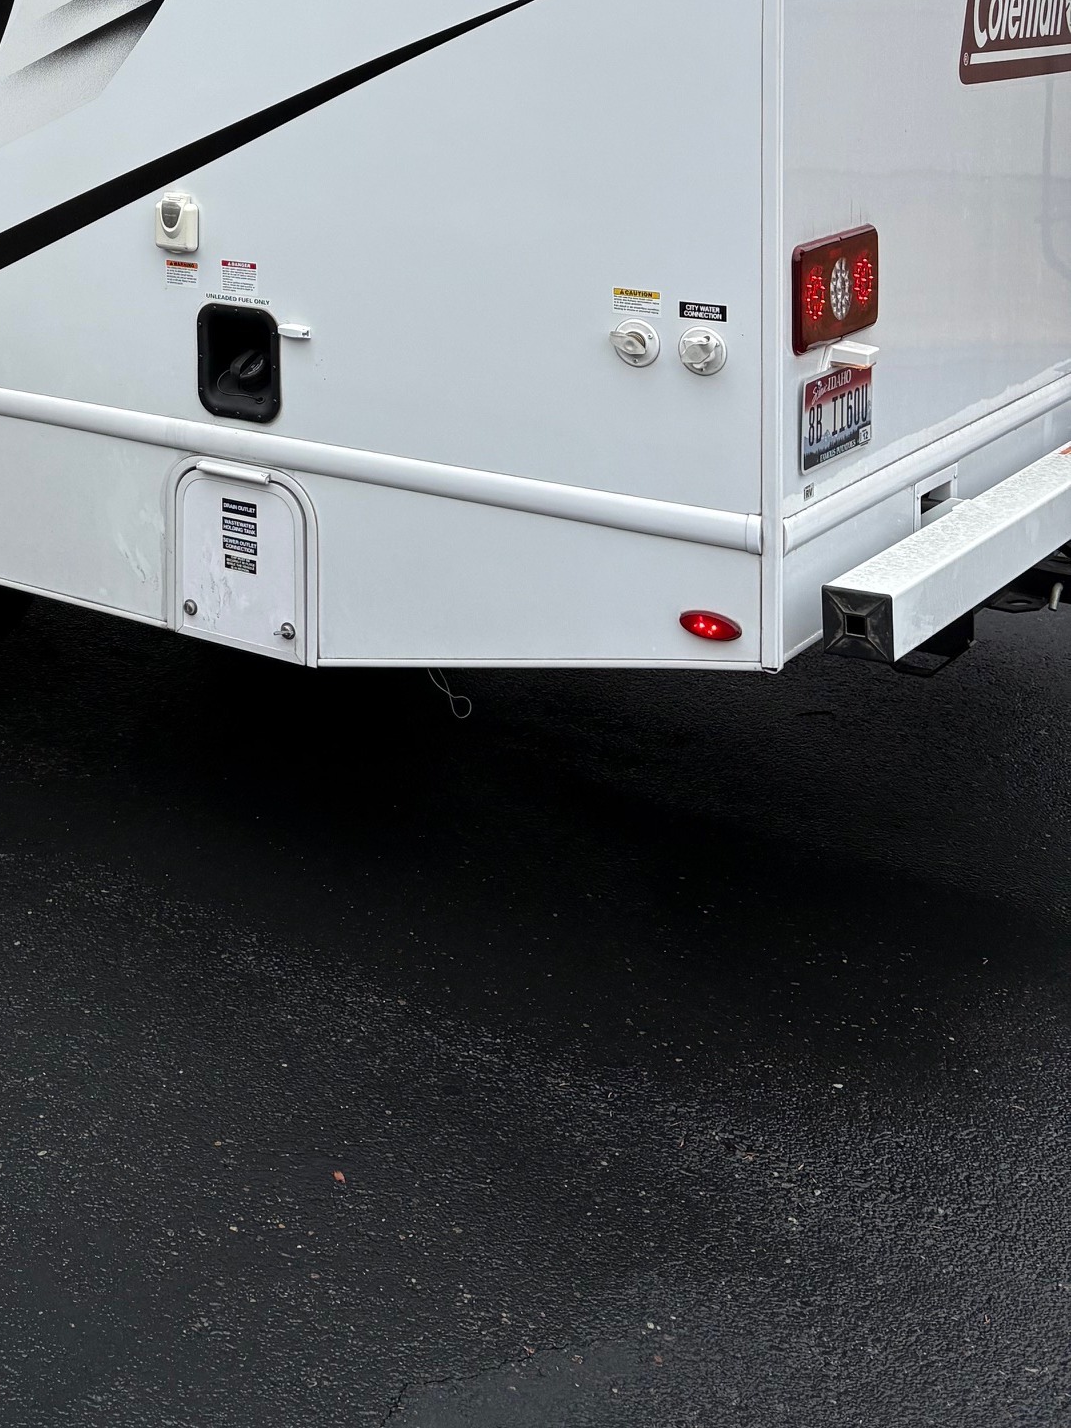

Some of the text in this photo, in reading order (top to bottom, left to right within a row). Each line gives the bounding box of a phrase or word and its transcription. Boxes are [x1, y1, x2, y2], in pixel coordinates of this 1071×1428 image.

[205, 293, 237, 302] UNLEADED
[624, 290, 653, 298] CAUTION
[699, 305, 720, 313] WATER
[683, 310, 722, 320] CONNECTION
[828, 369, 852, 391] IDAHO
[809, 404, 822, 446] 8B
